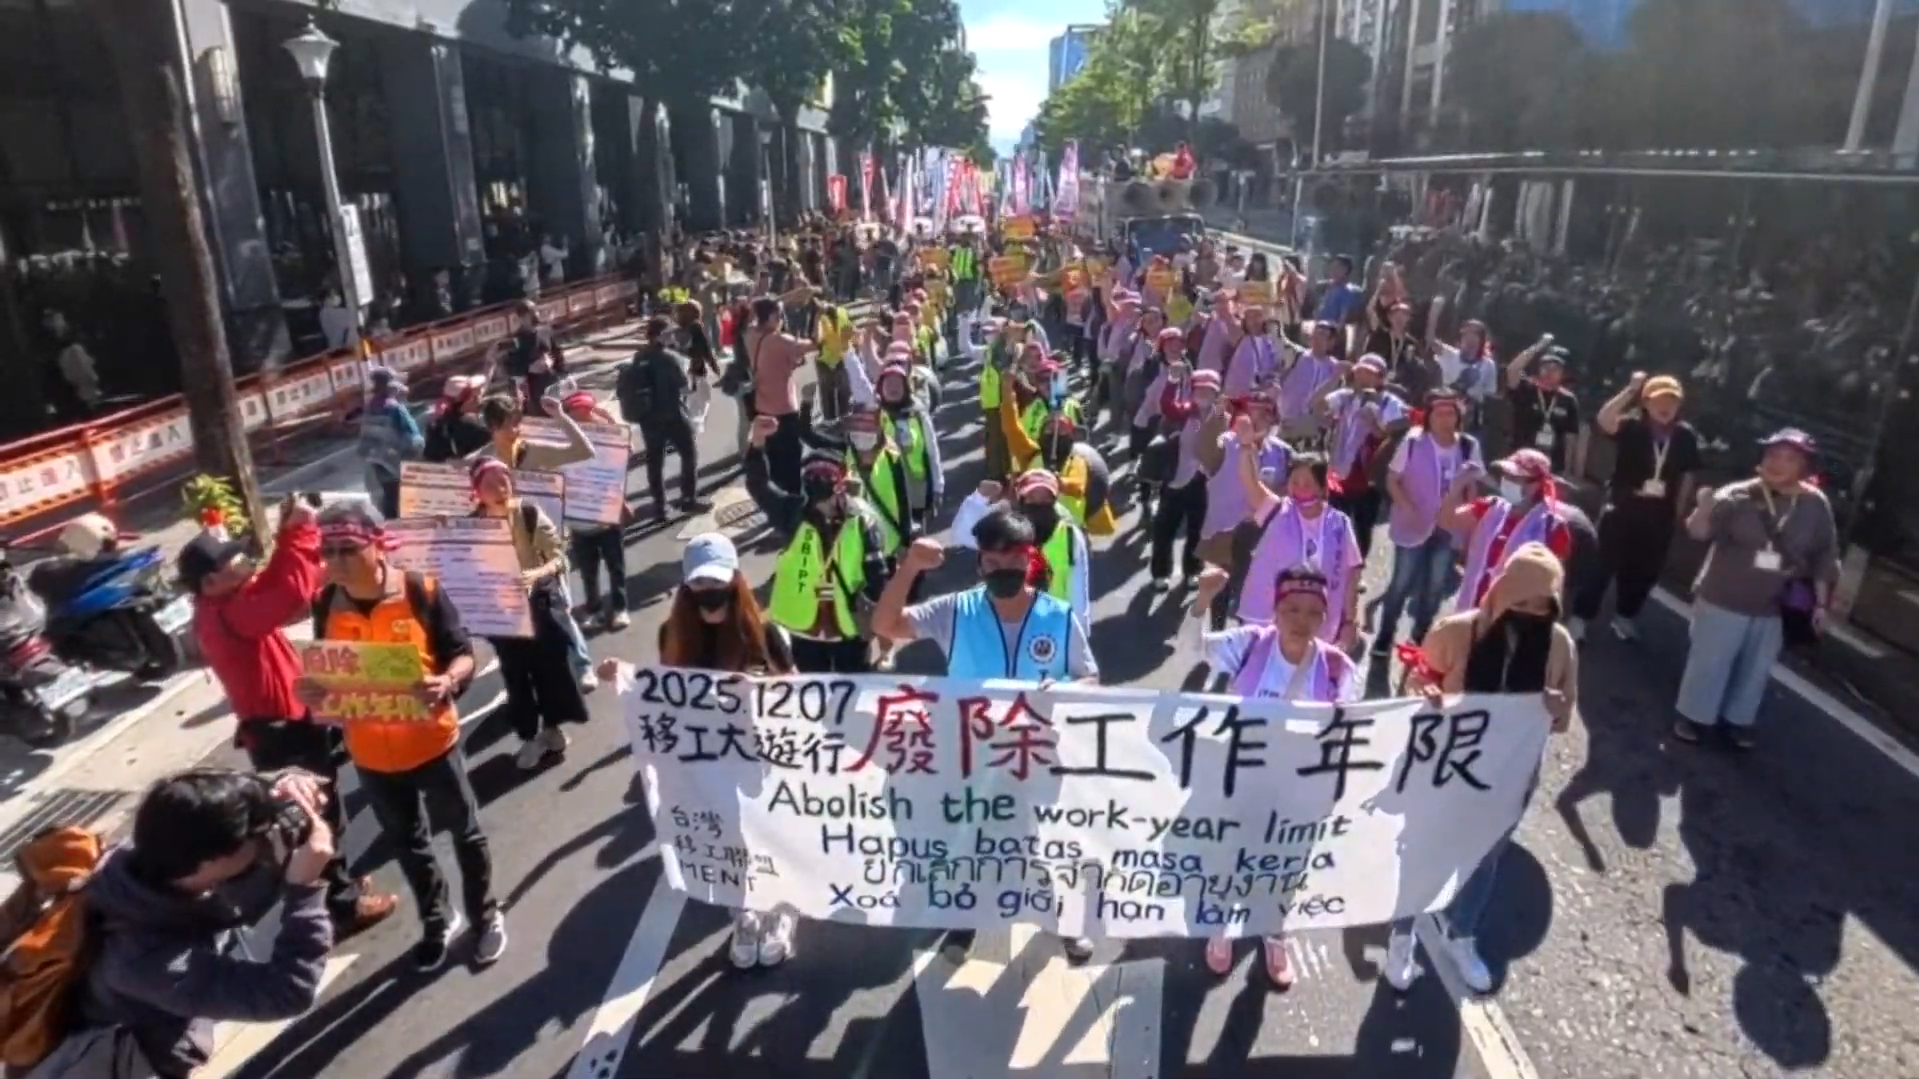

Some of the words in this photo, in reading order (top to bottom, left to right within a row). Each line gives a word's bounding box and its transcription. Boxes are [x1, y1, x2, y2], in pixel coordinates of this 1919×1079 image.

[639, 712, 846, 775] 移工大遊行
[843, 683, 1493, 801] 廢除工作年限
[671, 805, 724, 839] 台灣
[767, 780, 913, 820] Abolish
[941, 787, 1016, 823] the
[1034, 799, 1241, 842] work-year
[1264, 810, 1353, 844] limit
[822, 823, 948, 863] Hapus
[975, 828, 1083, 859] batas
[1112, 849, 1202, 872] masa
[1237, 847, 1335, 873] kerja
[679, 859, 758, 892] MENT
[829, 883, 901, 909] Xoá
[928, 880, 978, 910] bỏ
[1097, 892, 1165, 924] hạn
[1195, 898, 1250, 925] làm
[1277, 894, 1346, 919] việc
